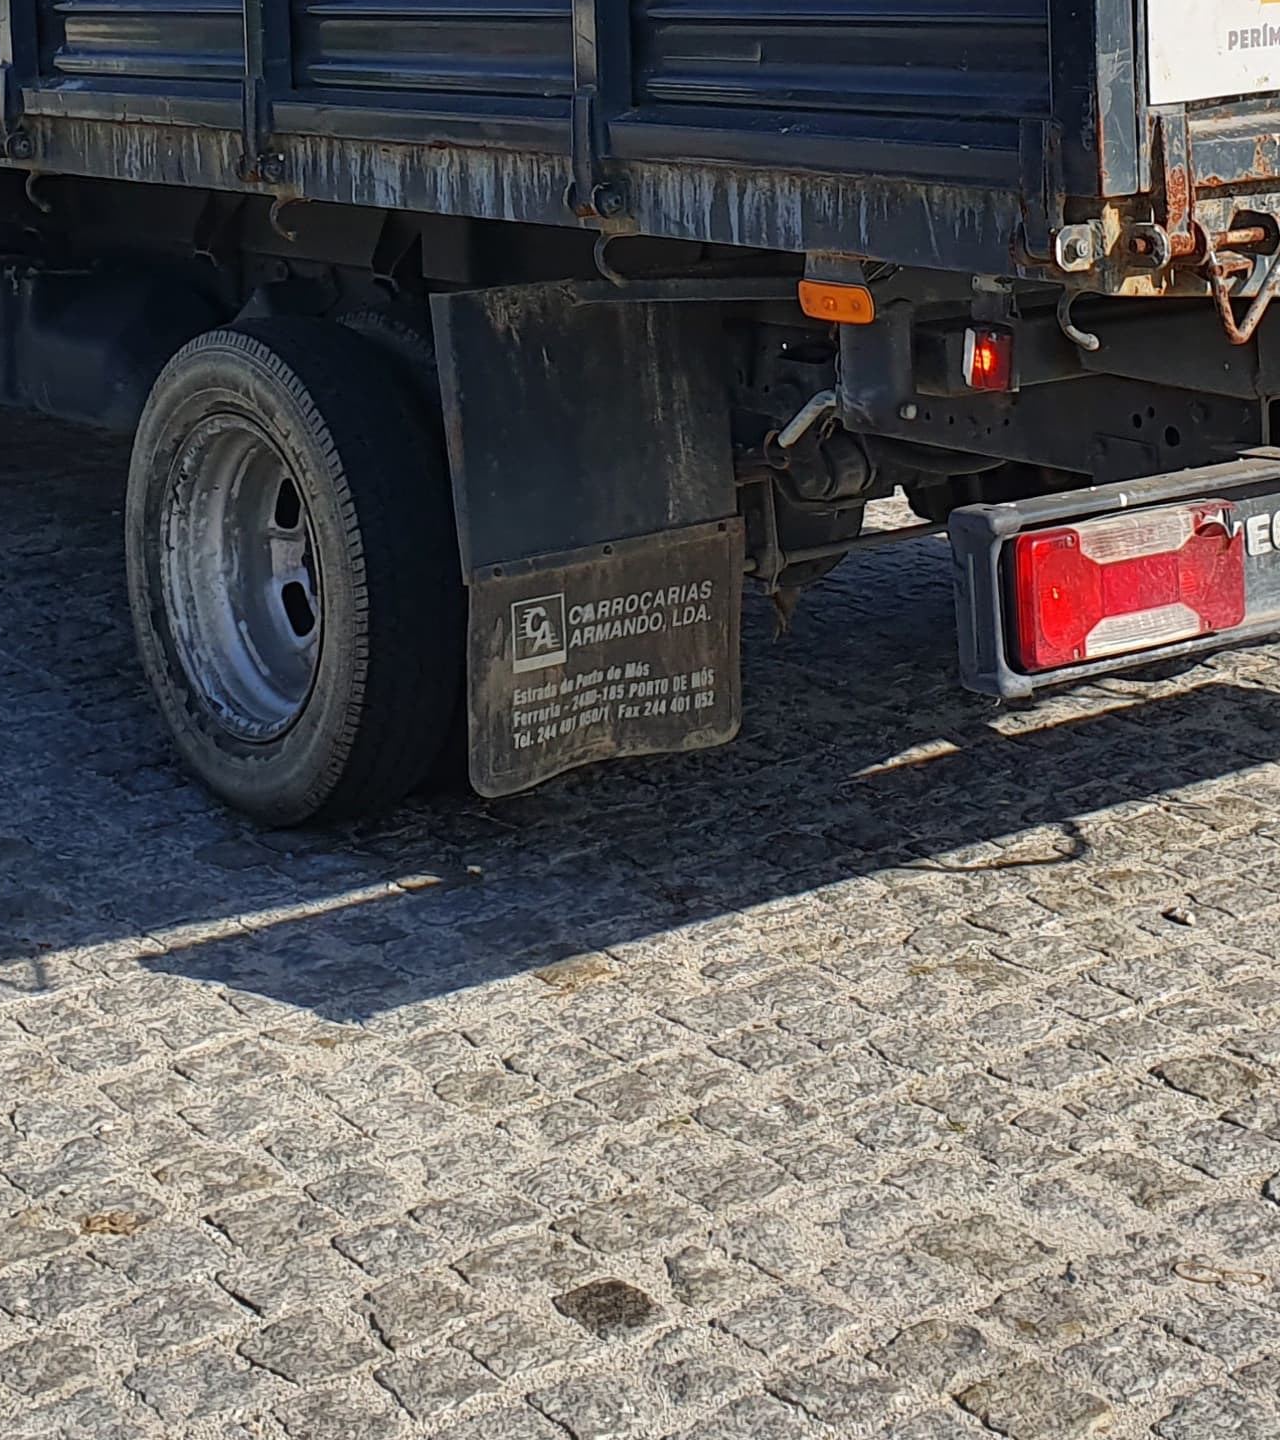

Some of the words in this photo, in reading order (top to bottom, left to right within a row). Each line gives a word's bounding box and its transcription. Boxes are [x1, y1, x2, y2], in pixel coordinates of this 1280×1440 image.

[569, 580, 713, 626] CARROÇARIAS
[569, 611, 668, 649] ARMANDO,
[672, 604, 712, 628] LDA.
[513, 682, 558, 707] Estrada
[575, 669, 603, 690] Porto
[606, 665, 621, 681] de
[625, 661, 650, 679] Mós
[513, 703, 561, 728] Ferraria
[628, 677, 669, 699] PORTO
[672, 674, 688, 693] DE
[691, 665, 715, 689] MÓS
[513, 731, 535, 750] Tel.
[537, 721, 557, 744] 244
[559, 716, 576, 735] 401
[617, 703, 640, 720] Fax
[643, 699, 668, 717] 244
[671, 694, 691, 713] 401
[694, 690, 715, 710] 052
